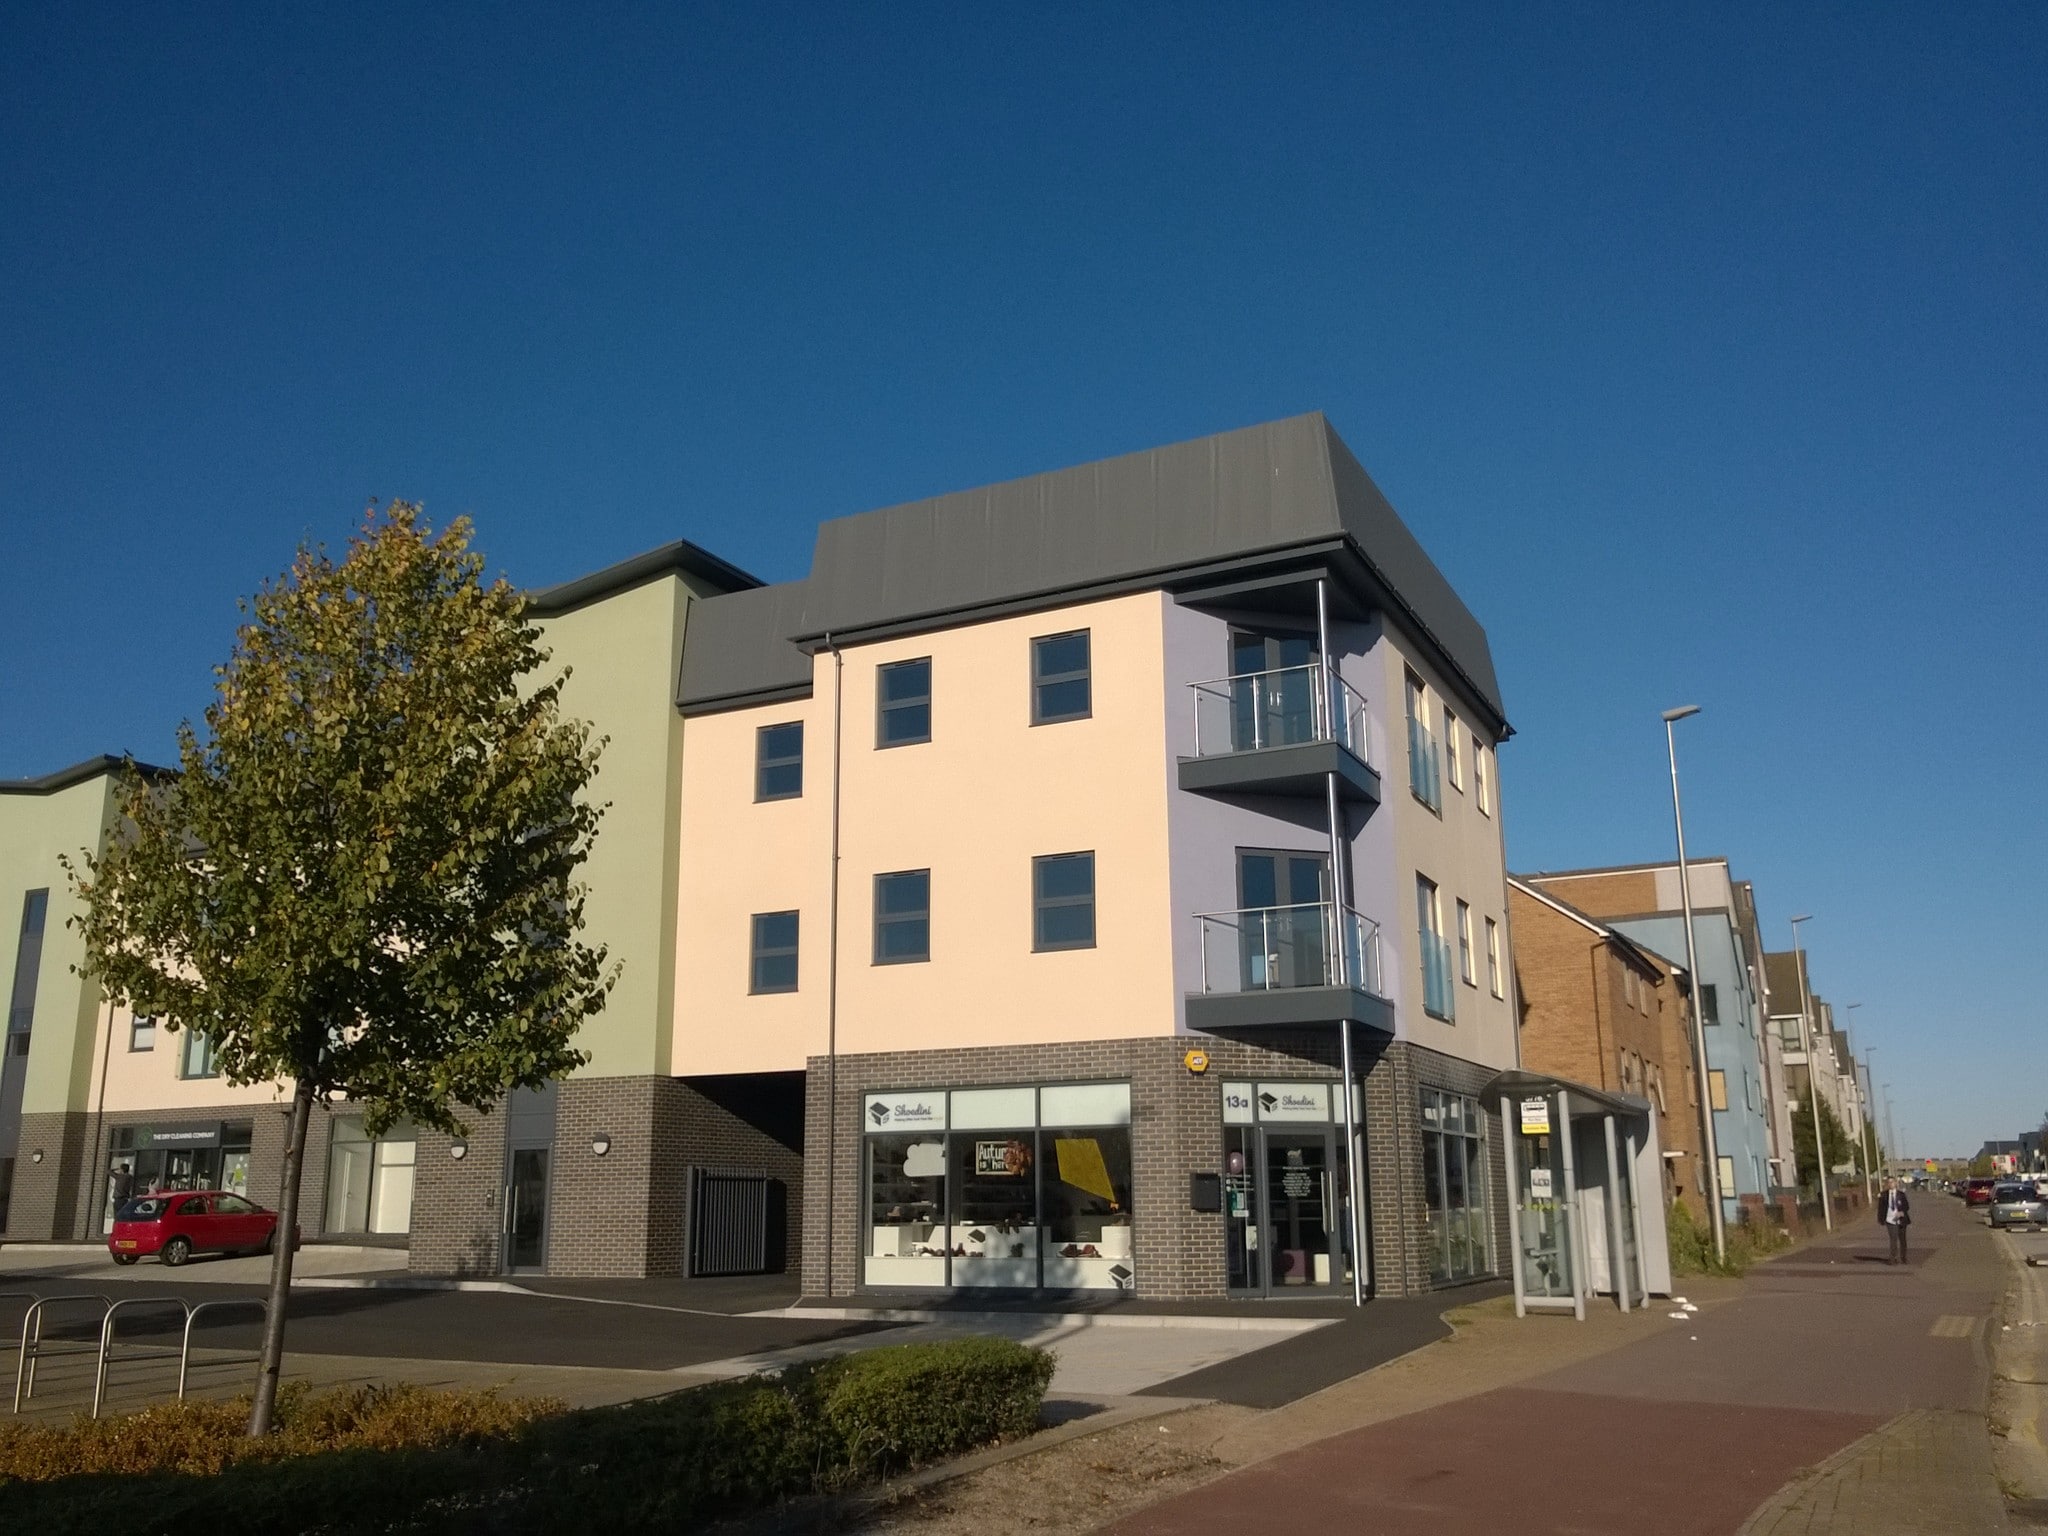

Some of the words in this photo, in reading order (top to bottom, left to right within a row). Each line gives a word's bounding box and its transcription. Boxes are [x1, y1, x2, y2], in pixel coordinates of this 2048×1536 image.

[1225, 1096, 1248, 1108] 13a
[1282, 1095, 1315, 1106] Shoedini
[894, 1103, 931, 1116] Shoedini
